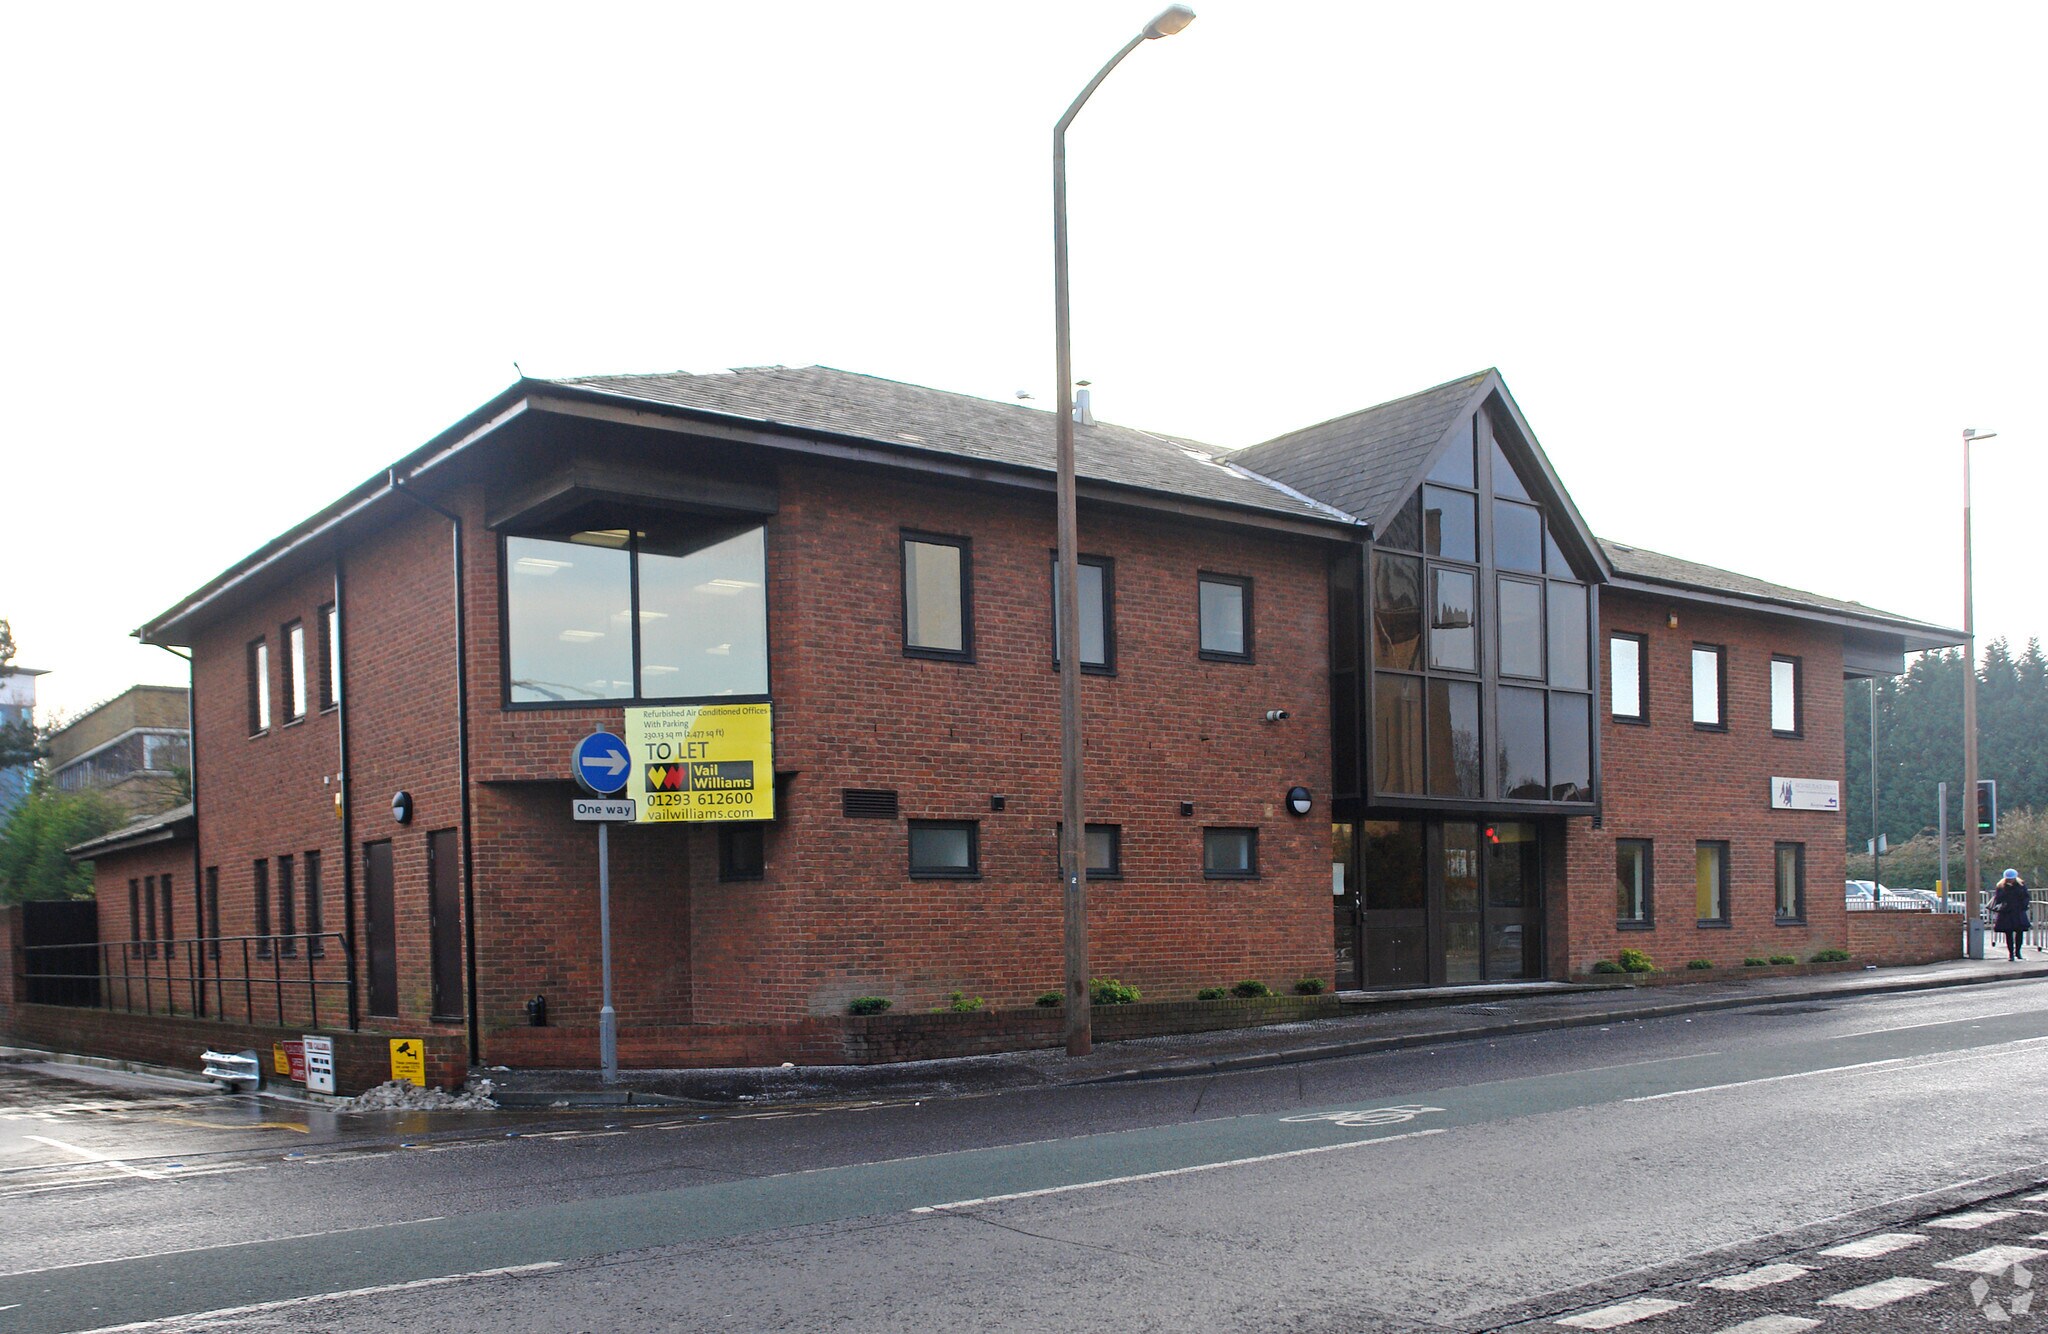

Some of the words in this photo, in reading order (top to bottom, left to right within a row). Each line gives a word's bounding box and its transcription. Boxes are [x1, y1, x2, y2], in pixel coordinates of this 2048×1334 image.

[643, 710, 685, 718] Refurbished
[686, 709, 697, 717] Air
[698, 708, 741, 717] Conditioned
[742, 707, 768, 715] Offices
[643, 720, 661, 728] With
[662, 720, 689, 729] Parking
[706, 730, 714, 738] sq
[715, 728, 725, 737] ft)
[645, 742, 672, 760] TO
[678, 741, 709, 759] LET
[693, 763, 718, 777] Vail
[693, 776, 752, 789] Williams
[647, 794, 690, 807] 01293
[697, 792, 753, 805] 612600
[577, 803, 602, 814] One
[605, 806, 631, 817] way
[647, 808, 754, 820] vailwilliams.com
